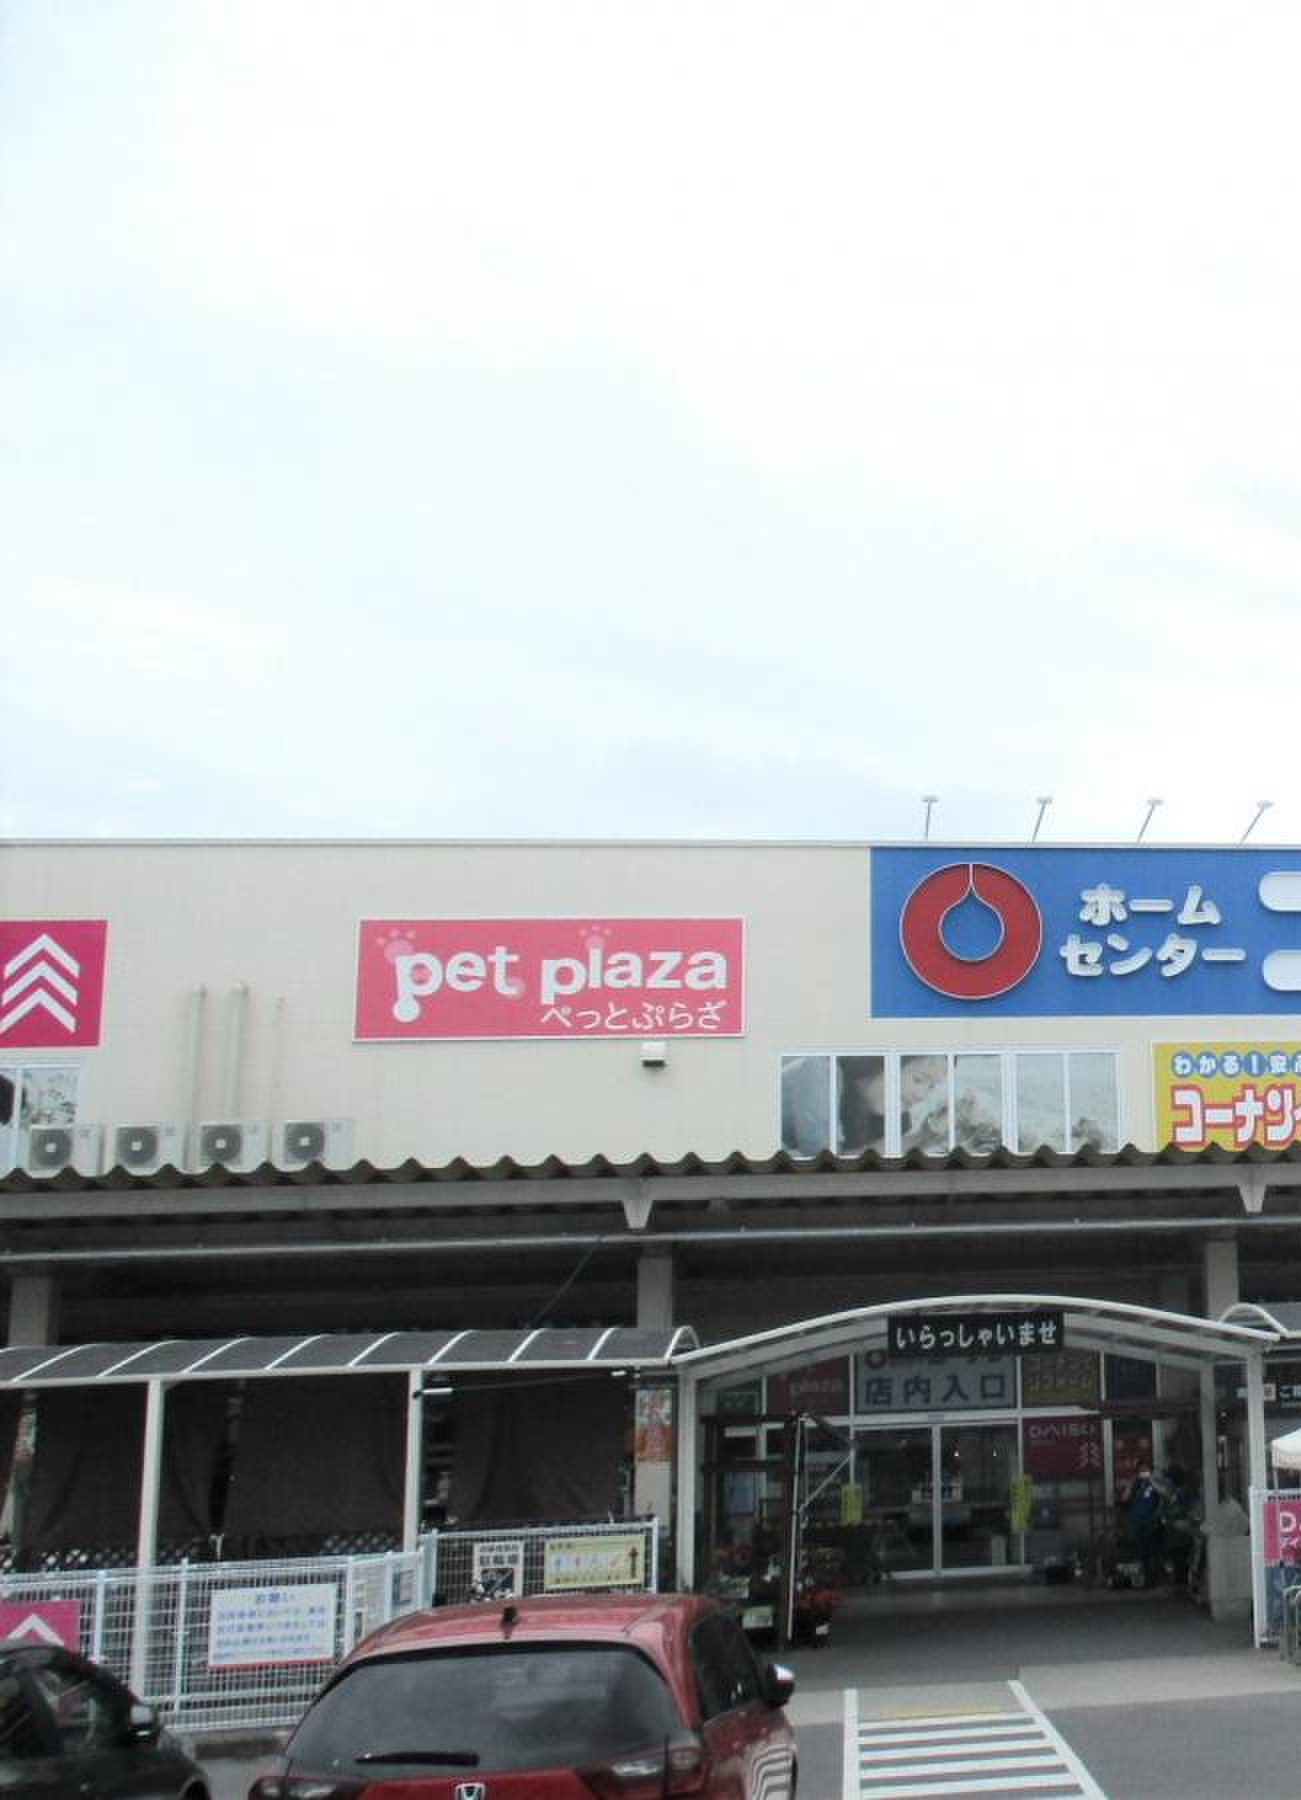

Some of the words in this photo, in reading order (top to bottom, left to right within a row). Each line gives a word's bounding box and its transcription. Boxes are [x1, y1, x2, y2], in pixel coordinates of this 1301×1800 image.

[1079, 883, 1221, 926] ホーム
[1060, 933, 1247, 977] センター
[391, 944, 520, 1023] pet
[541, 948, 727, 1004] plaza
[541, 1000, 726, 1030] ぺっとぷらざ
[896, 1321, 1057, 1350] いらっしゃいませ
[865, 1373, 1006, 1405] 店内入口
